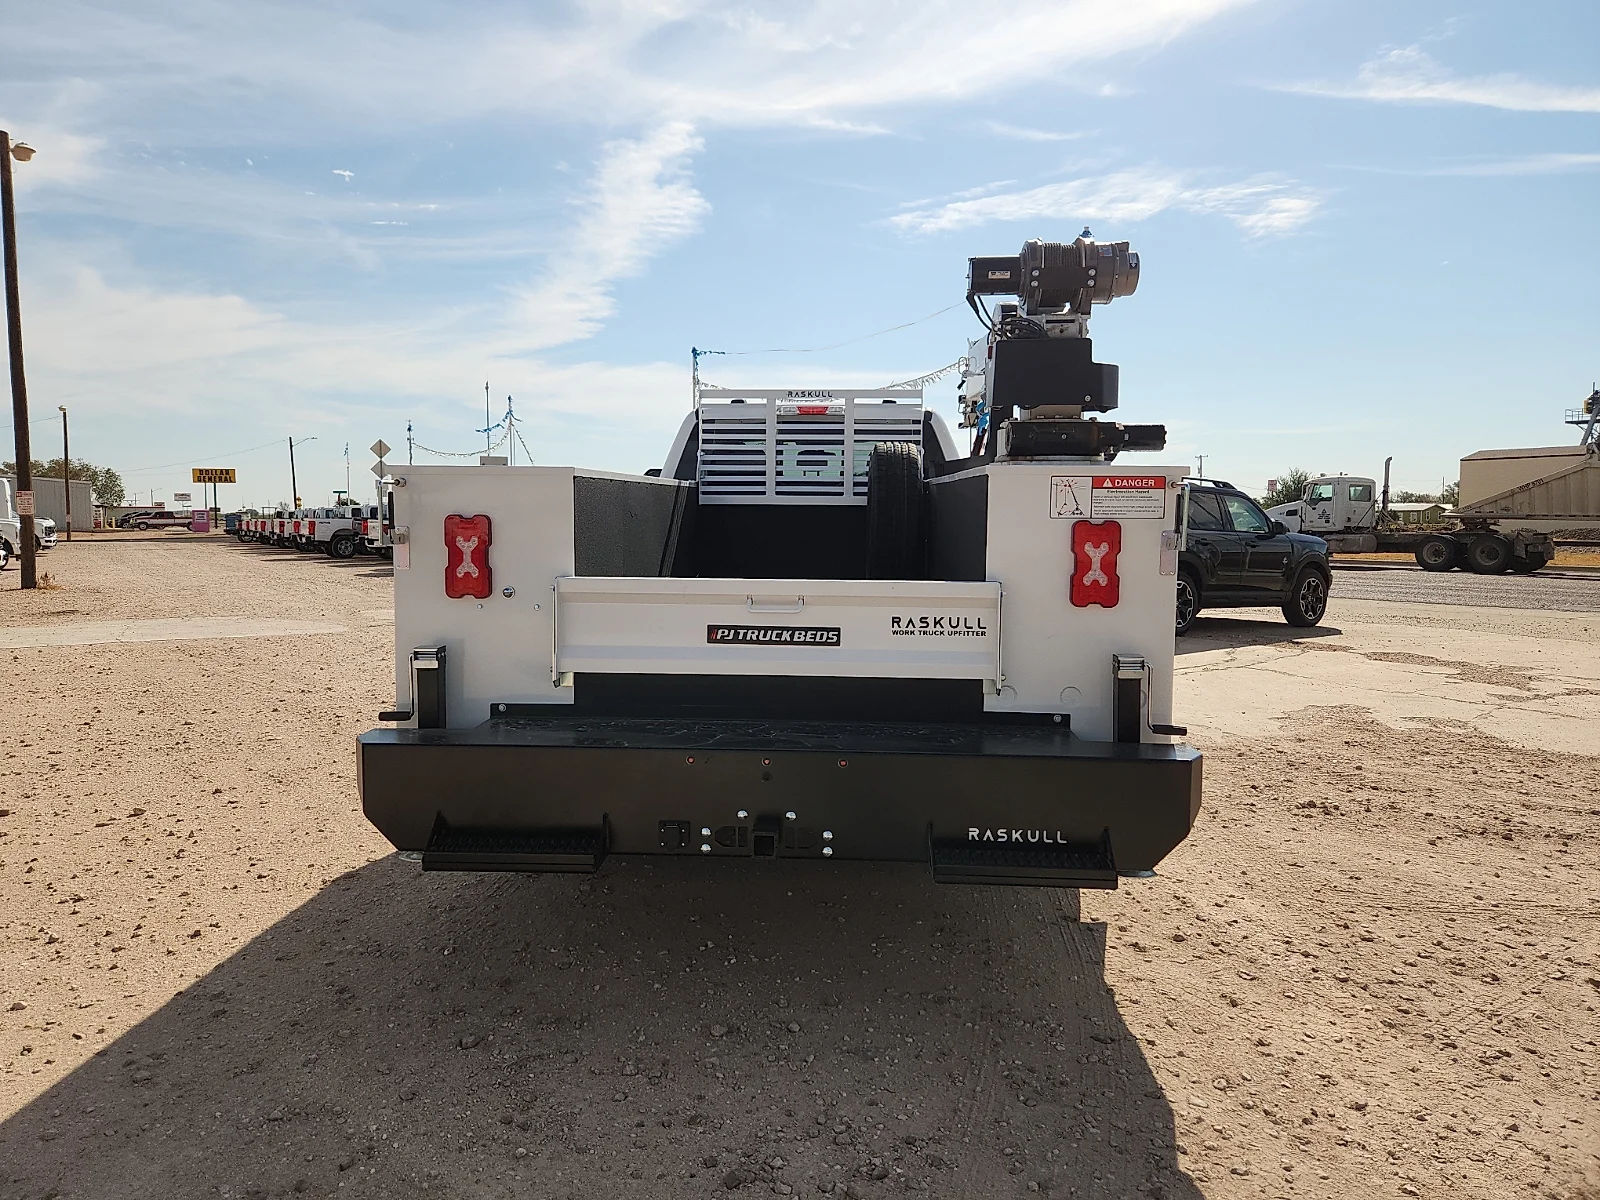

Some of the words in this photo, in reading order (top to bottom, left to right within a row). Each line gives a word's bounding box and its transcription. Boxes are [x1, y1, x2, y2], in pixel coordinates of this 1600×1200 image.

[787, 390, 833, 398] RASKULL
[197, 475, 234, 483] GENERAL
[1114, 479, 1155, 487] DANGER
[891, 616, 987, 630] RASKULL
[716, 628, 735, 641] PJ
[918, 629, 946, 637] TRUCK
[968, 827, 1068, 844] RASKULL
